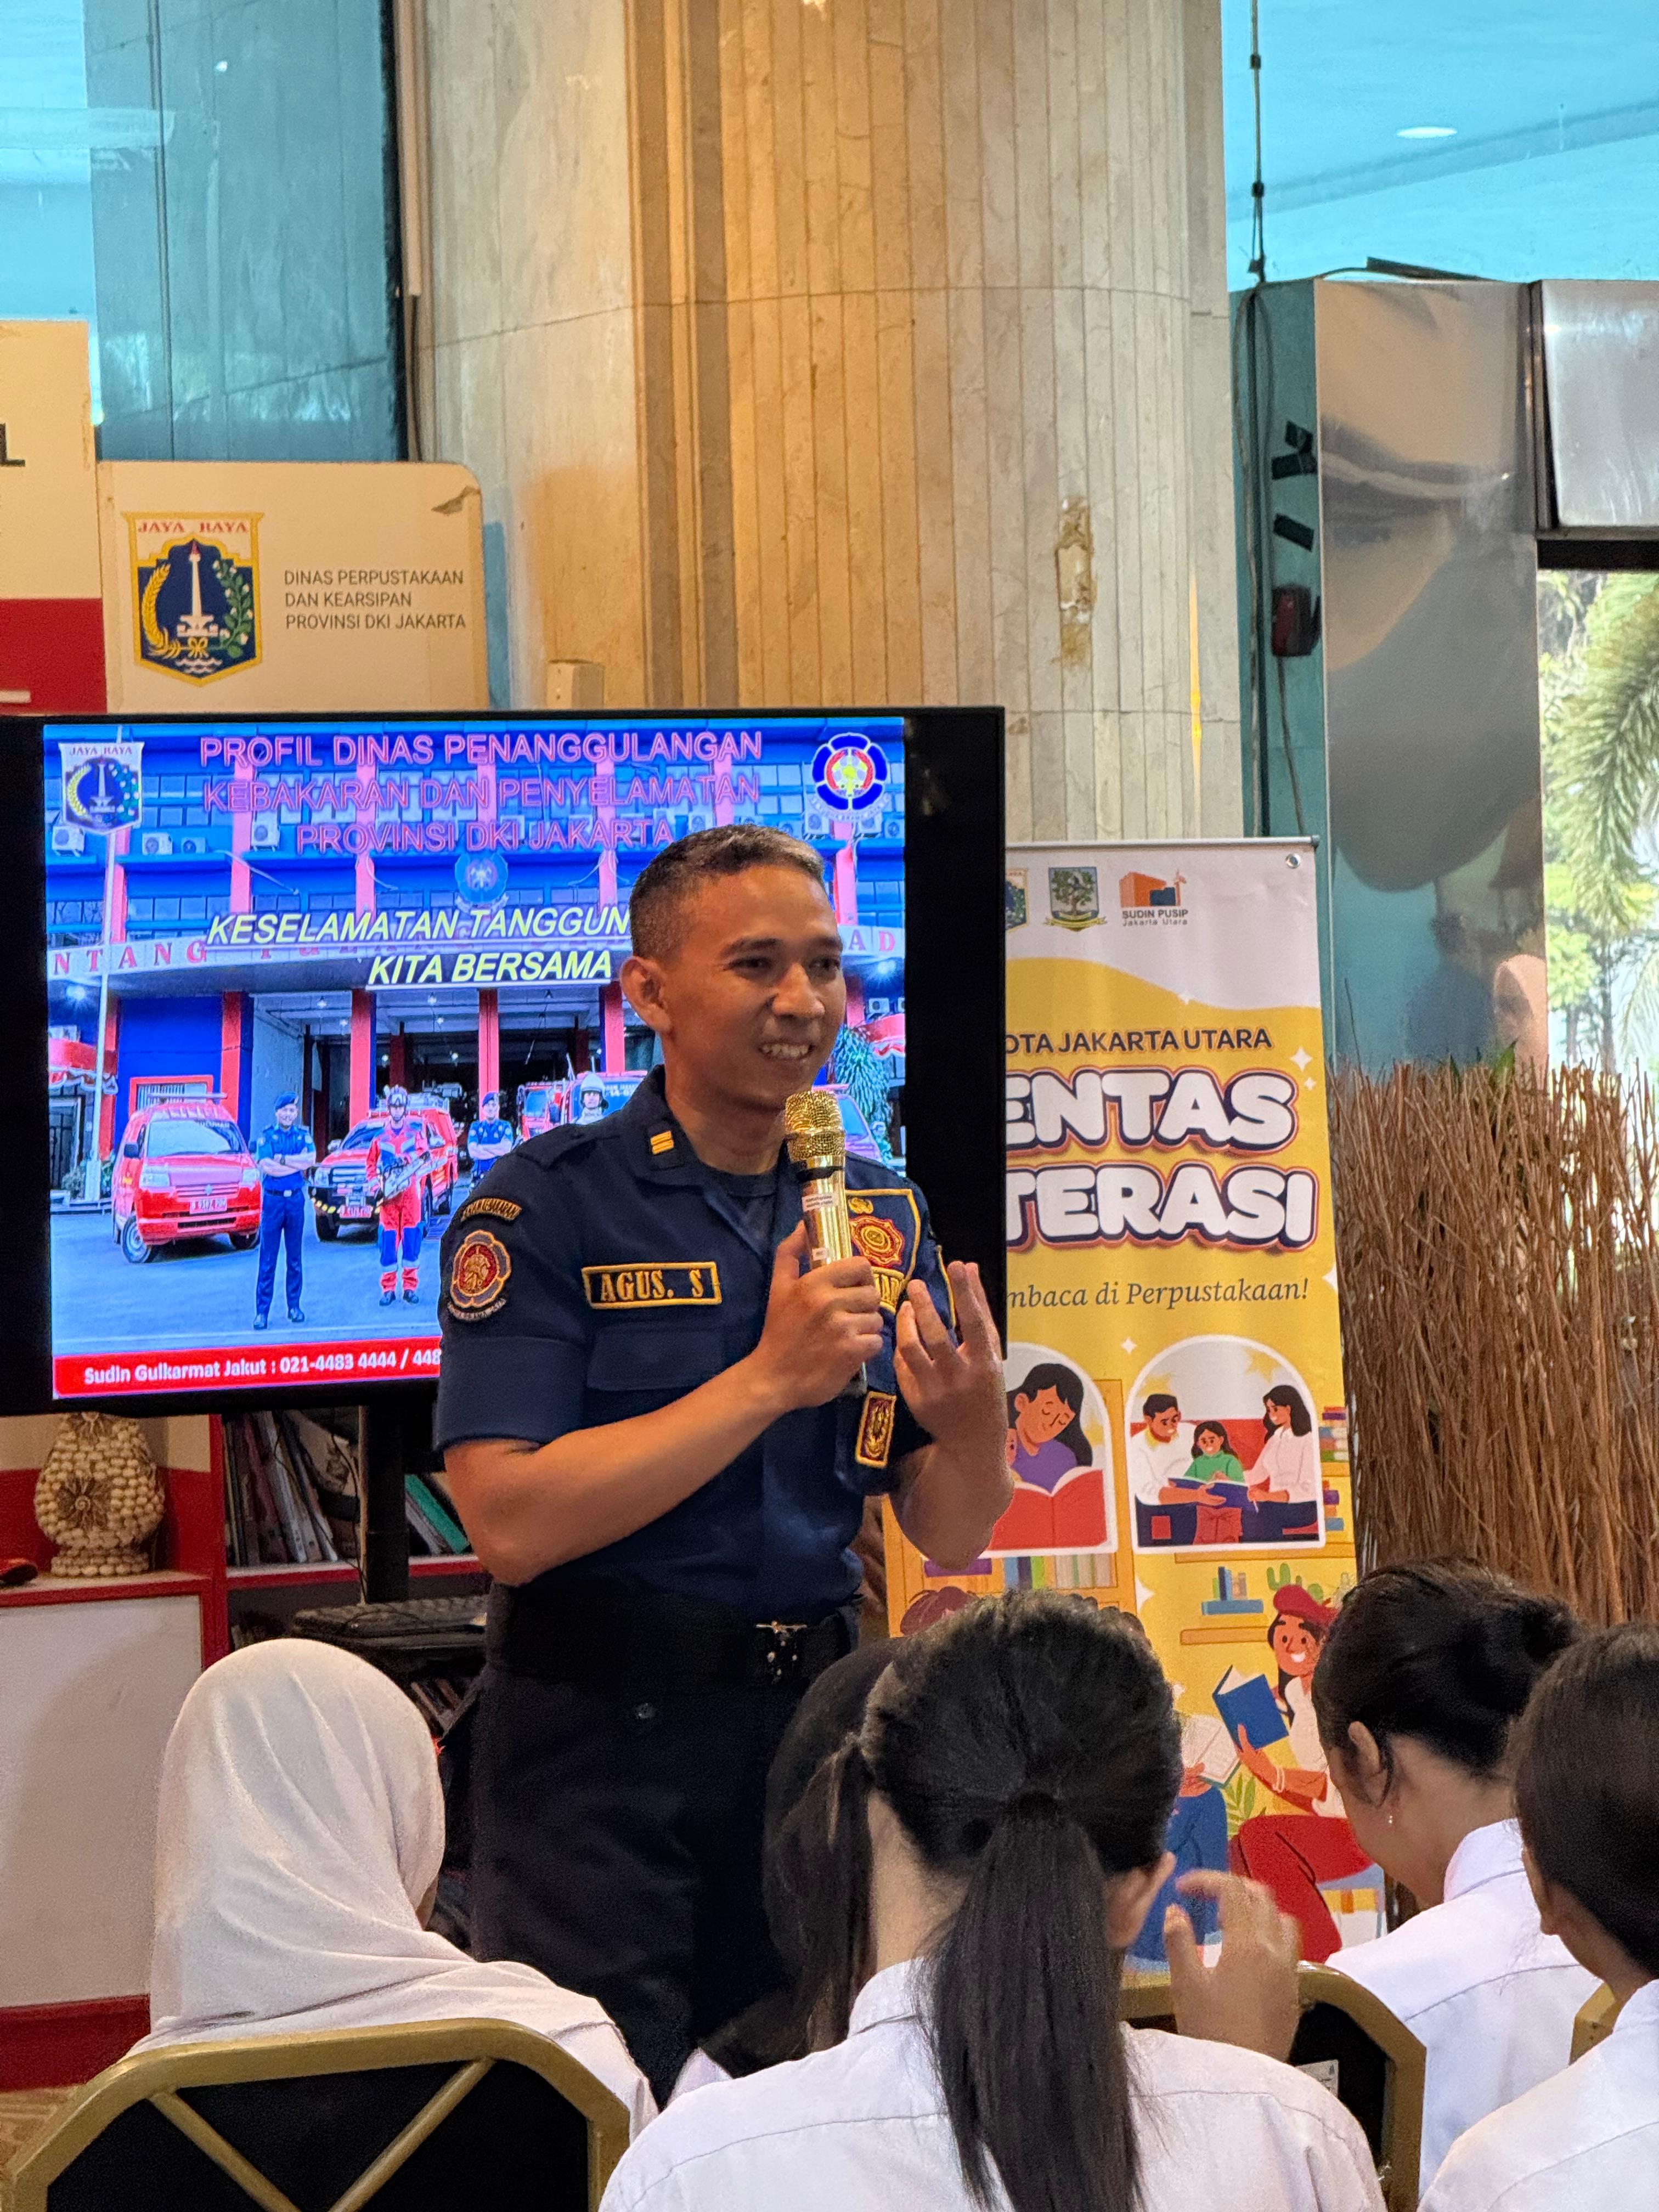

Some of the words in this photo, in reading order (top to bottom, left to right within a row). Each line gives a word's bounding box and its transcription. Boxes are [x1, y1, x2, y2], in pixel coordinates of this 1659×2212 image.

[138, 522, 184, 533] JAYA
[284, 570, 333, 585] DINAS
[338, 569, 464, 585] PERPUSTAKAAN
[285, 592, 318, 607] DAN
[324, 592, 411, 607] KEARSIPAN
[286, 614, 360, 629] PROVINSI
[365, 614, 390, 629] DKI
[396, 614, 466, 629] JAKARTA
[200, 736, 323, 767] PROFIL
[333, 735, 434, 765] DINAS
[444, 731, 762, 764] PENANGGULANGAN
[204, 779, 408, 812] KEBAKARAN
[420, 778, 488, 808] DAN
[499, 774, 760, 807] PENYELAMATAN
[296, 822, 455, 855] PROVINSI
[466, 821, 518, 851] DKI
[530, 819, 674, 850] JAKARTA
[207, 911, 459, 944] KESELAMATAN
[1122, 910, 1155, 919] SUDIN
[1158, 909, 1188, 918] PUSIP
[368, 954, 443, 985] KITA
[452, 950, 612, 983] BERSAMA
[1006, 1031, 1054, 1054] OTA
[1058, 1028, 1180, 1052] JAKARTA
[1183, 1028, 1272, 1048] UTARA
[1006, 1068, 1299, 1153] ENTAS
[1006, 1162, 1318, 1250] TERASI
[600, 1269, 674, 1302] AGUS.
[689, 1268, 704, 1298] S
[1095, 1282, 1118, 1305] di
[1126, 1278, 1309, 1310] Perpustakaan!
[84, 1366, 131, 1385] Sudin
[135, 1362, 221, 1381] Gulkarmat
[224, 1357, 267, 1378] Jakut
[280, 1353, 354, 1373] 021-4483
[358, 1351, 396, 1369] 4444
[400, 1348, 410, 1370] /
